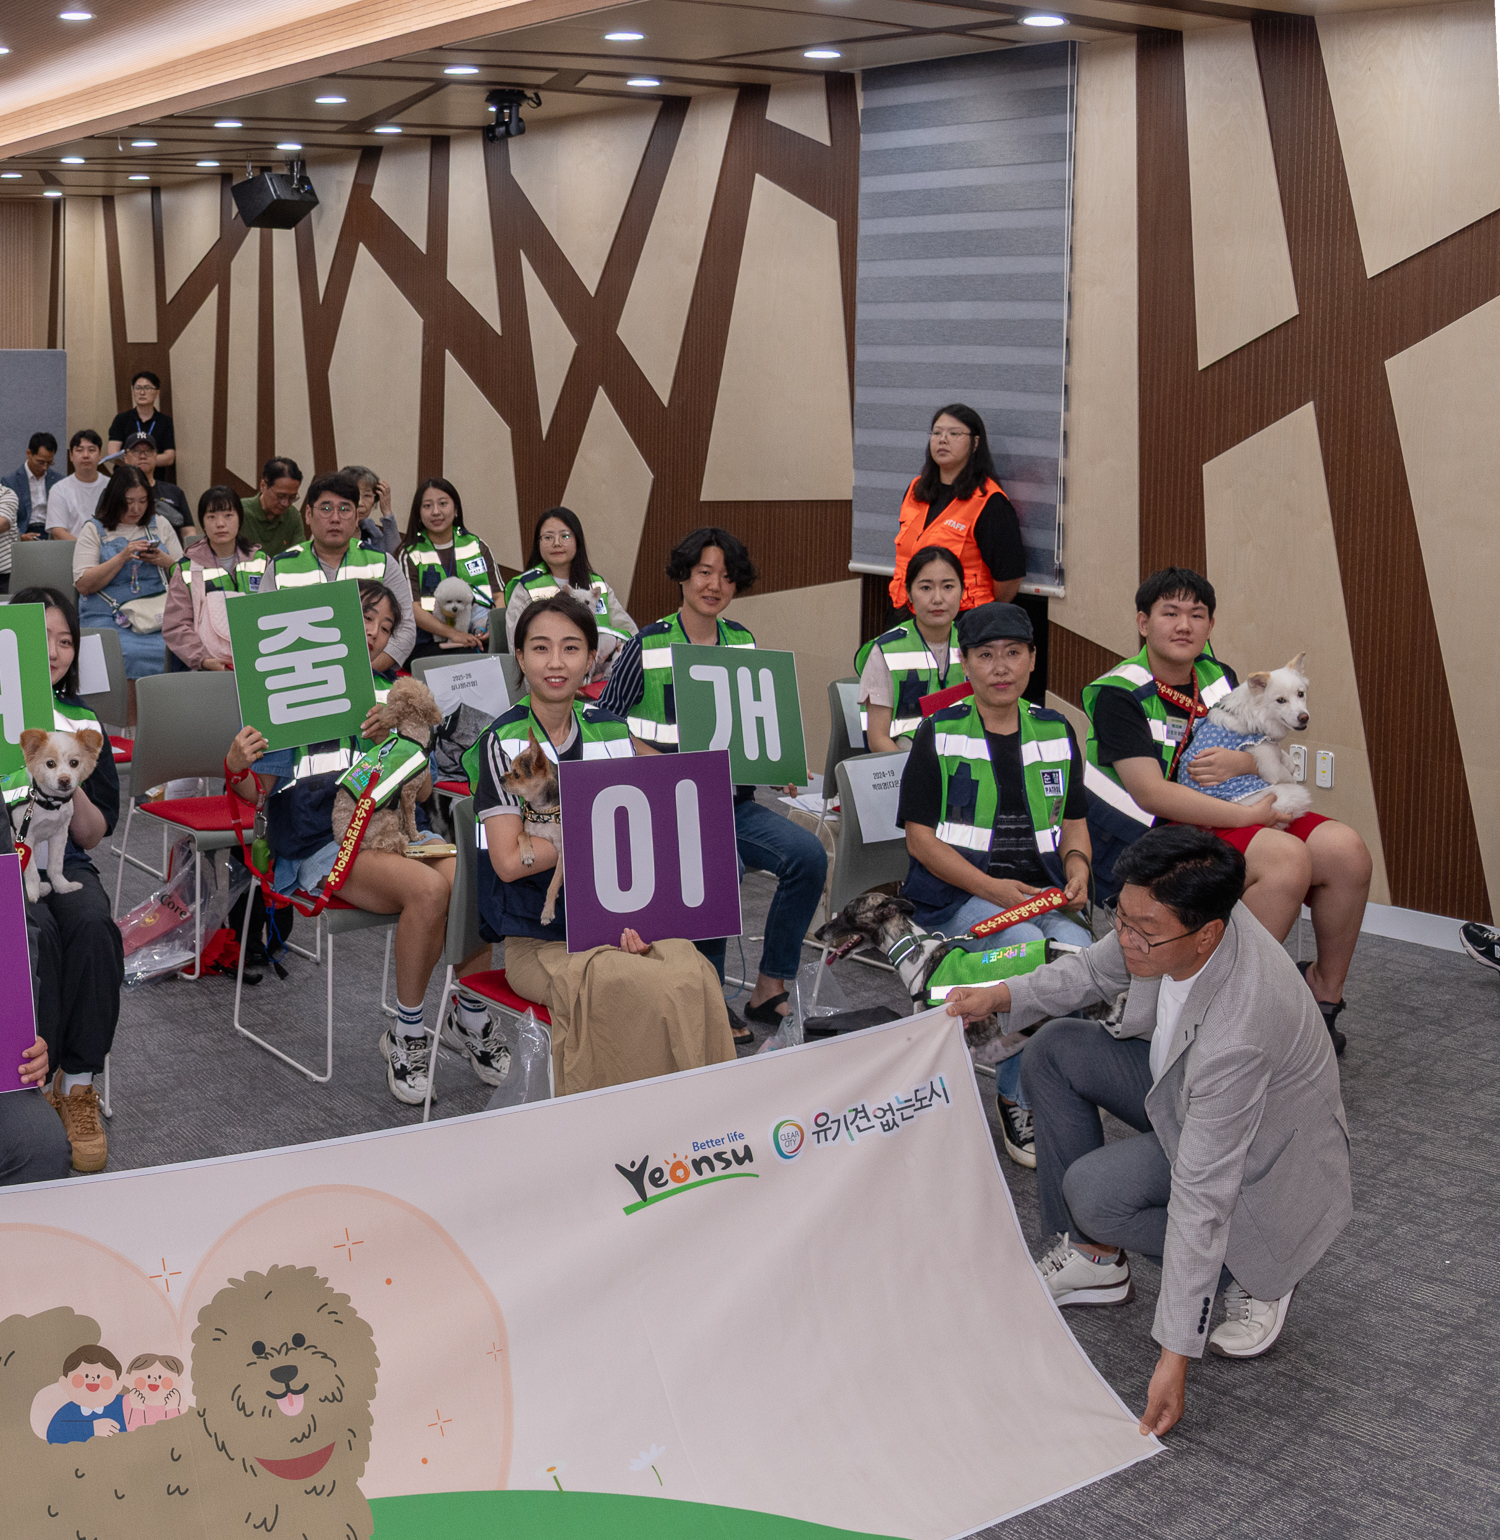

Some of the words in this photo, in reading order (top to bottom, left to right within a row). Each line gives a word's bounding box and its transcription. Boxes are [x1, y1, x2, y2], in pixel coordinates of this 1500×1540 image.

[944, 519, 966, 531] STAFF
[254, 606, 351, 725] 줄
[689, 665, 782, 762] 개
[1043, 773, 1059, 784] 순찰
[334, 799, 372, 872] 연수지킴댕댕이
[592, 779, 705, 913] 이
[160, 893, 187, 919] Core
[975, 897, 1049, 933] 연수지킴댕댕이
[692, 1136, 725, 1152] Better
[727, 1131, 746, 1144] life
[780, 1130, 800, 1142] CLEAR
[784, 1139, 797, 1148] CITY
[615, 1145, 754, 1203] Yeonsu
